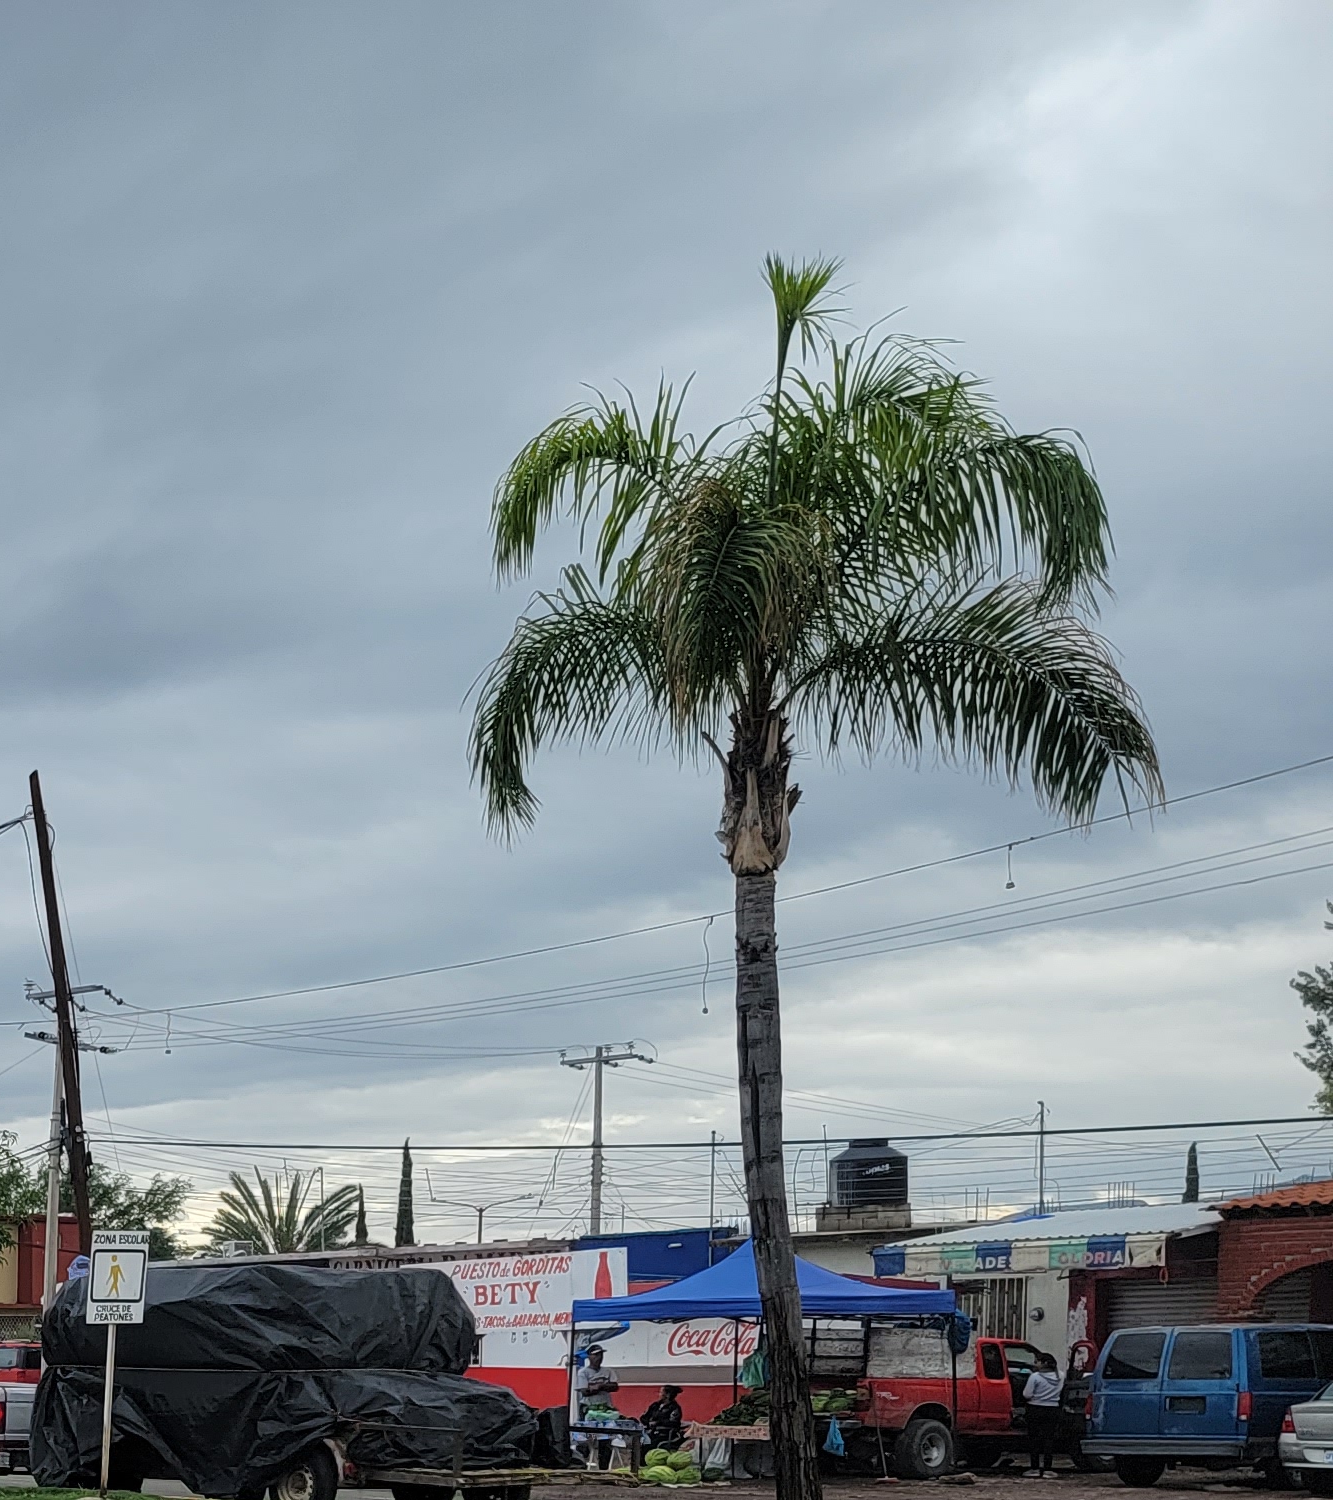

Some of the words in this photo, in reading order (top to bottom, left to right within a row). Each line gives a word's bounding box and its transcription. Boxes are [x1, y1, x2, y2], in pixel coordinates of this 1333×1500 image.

[94, 1234, 117, 1244] ZONA
[118, 1234, 150, 1245] ESCOLAR
[451, 1261, 500, 1280] PUESTO
[500, 1262, 511, 1278] de
[512, 1255, 573, 1279] GORDITAS
[96, 1305, 121, 1313] CRUCE
[94, 1313, 134, 1321] PEATONES
[668, 1321, 756, 1356] Coca-Cola
